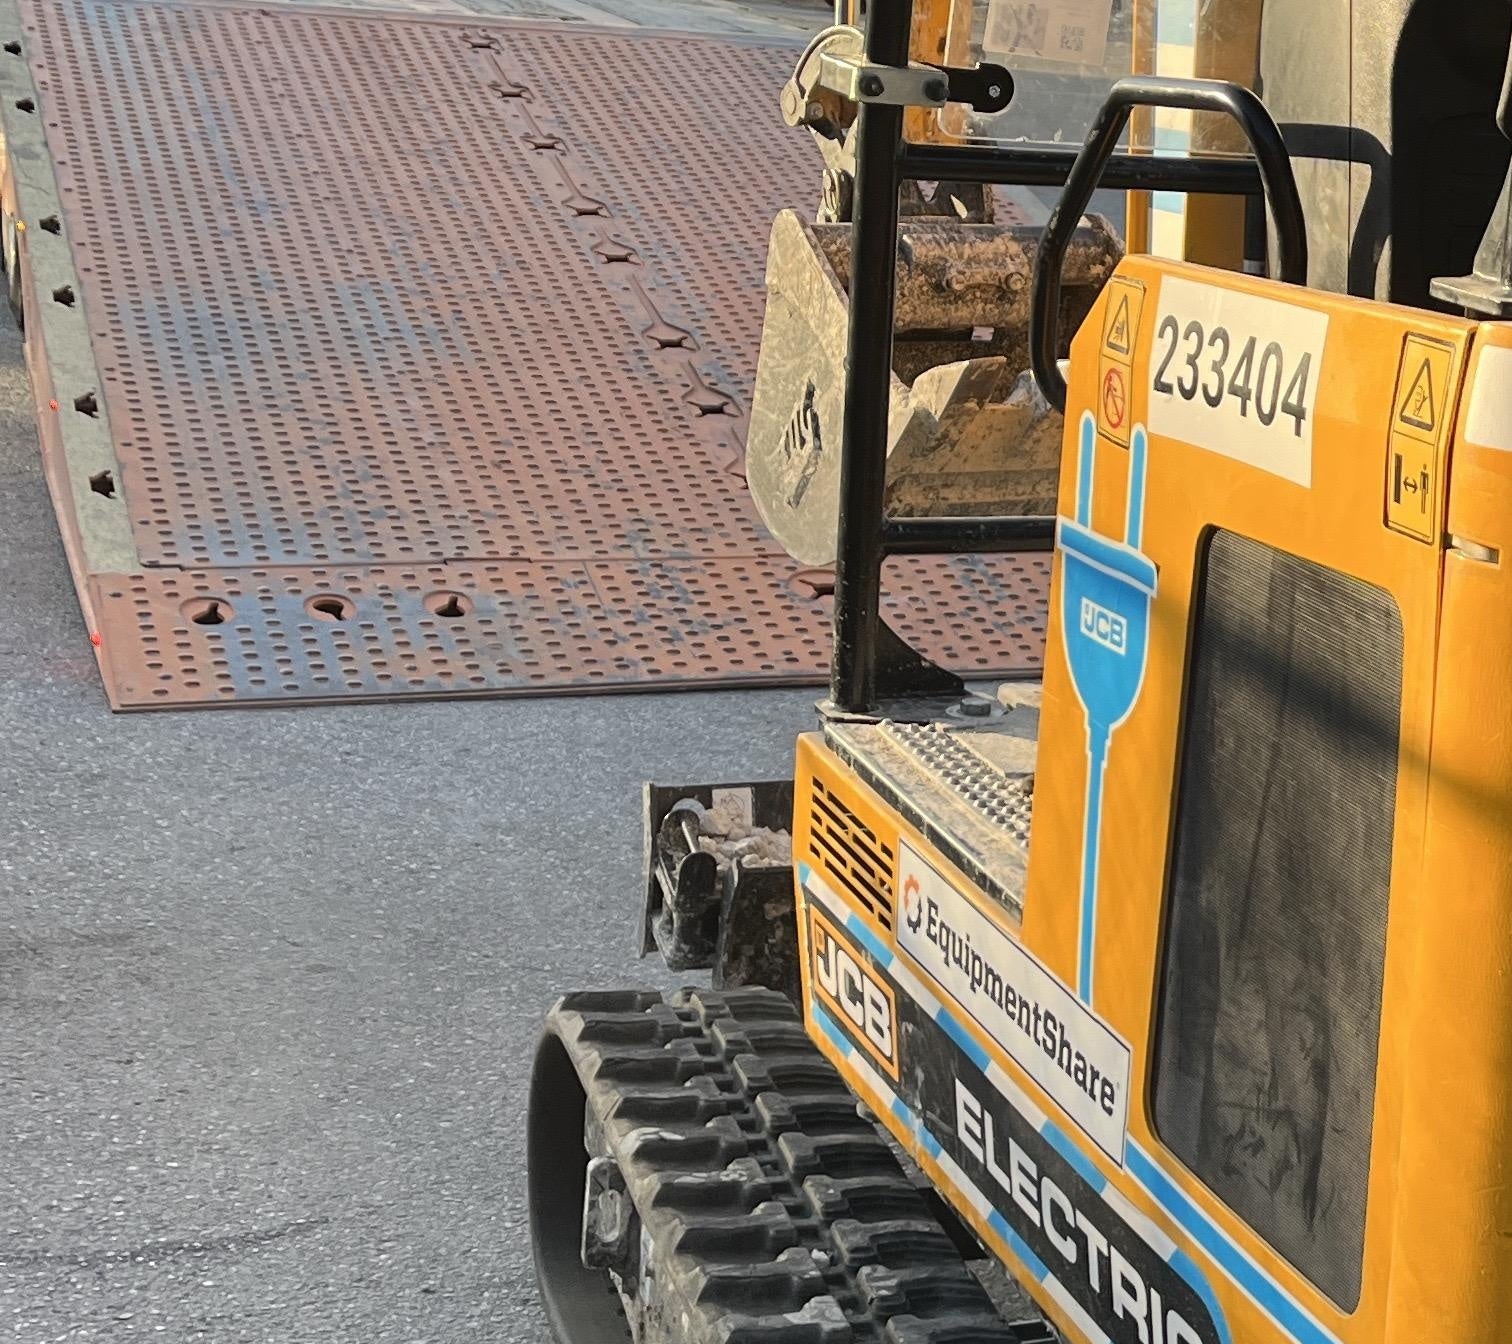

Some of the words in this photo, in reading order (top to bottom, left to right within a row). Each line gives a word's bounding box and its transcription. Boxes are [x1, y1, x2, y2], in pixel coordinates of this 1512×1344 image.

[1153, 314, 1312, 438] 233404
[1084, 602, 1123, 648] JCB
[816, 934, 893, 1058] JCB
[926, 896, 1115, 1117] EquipmentShare
